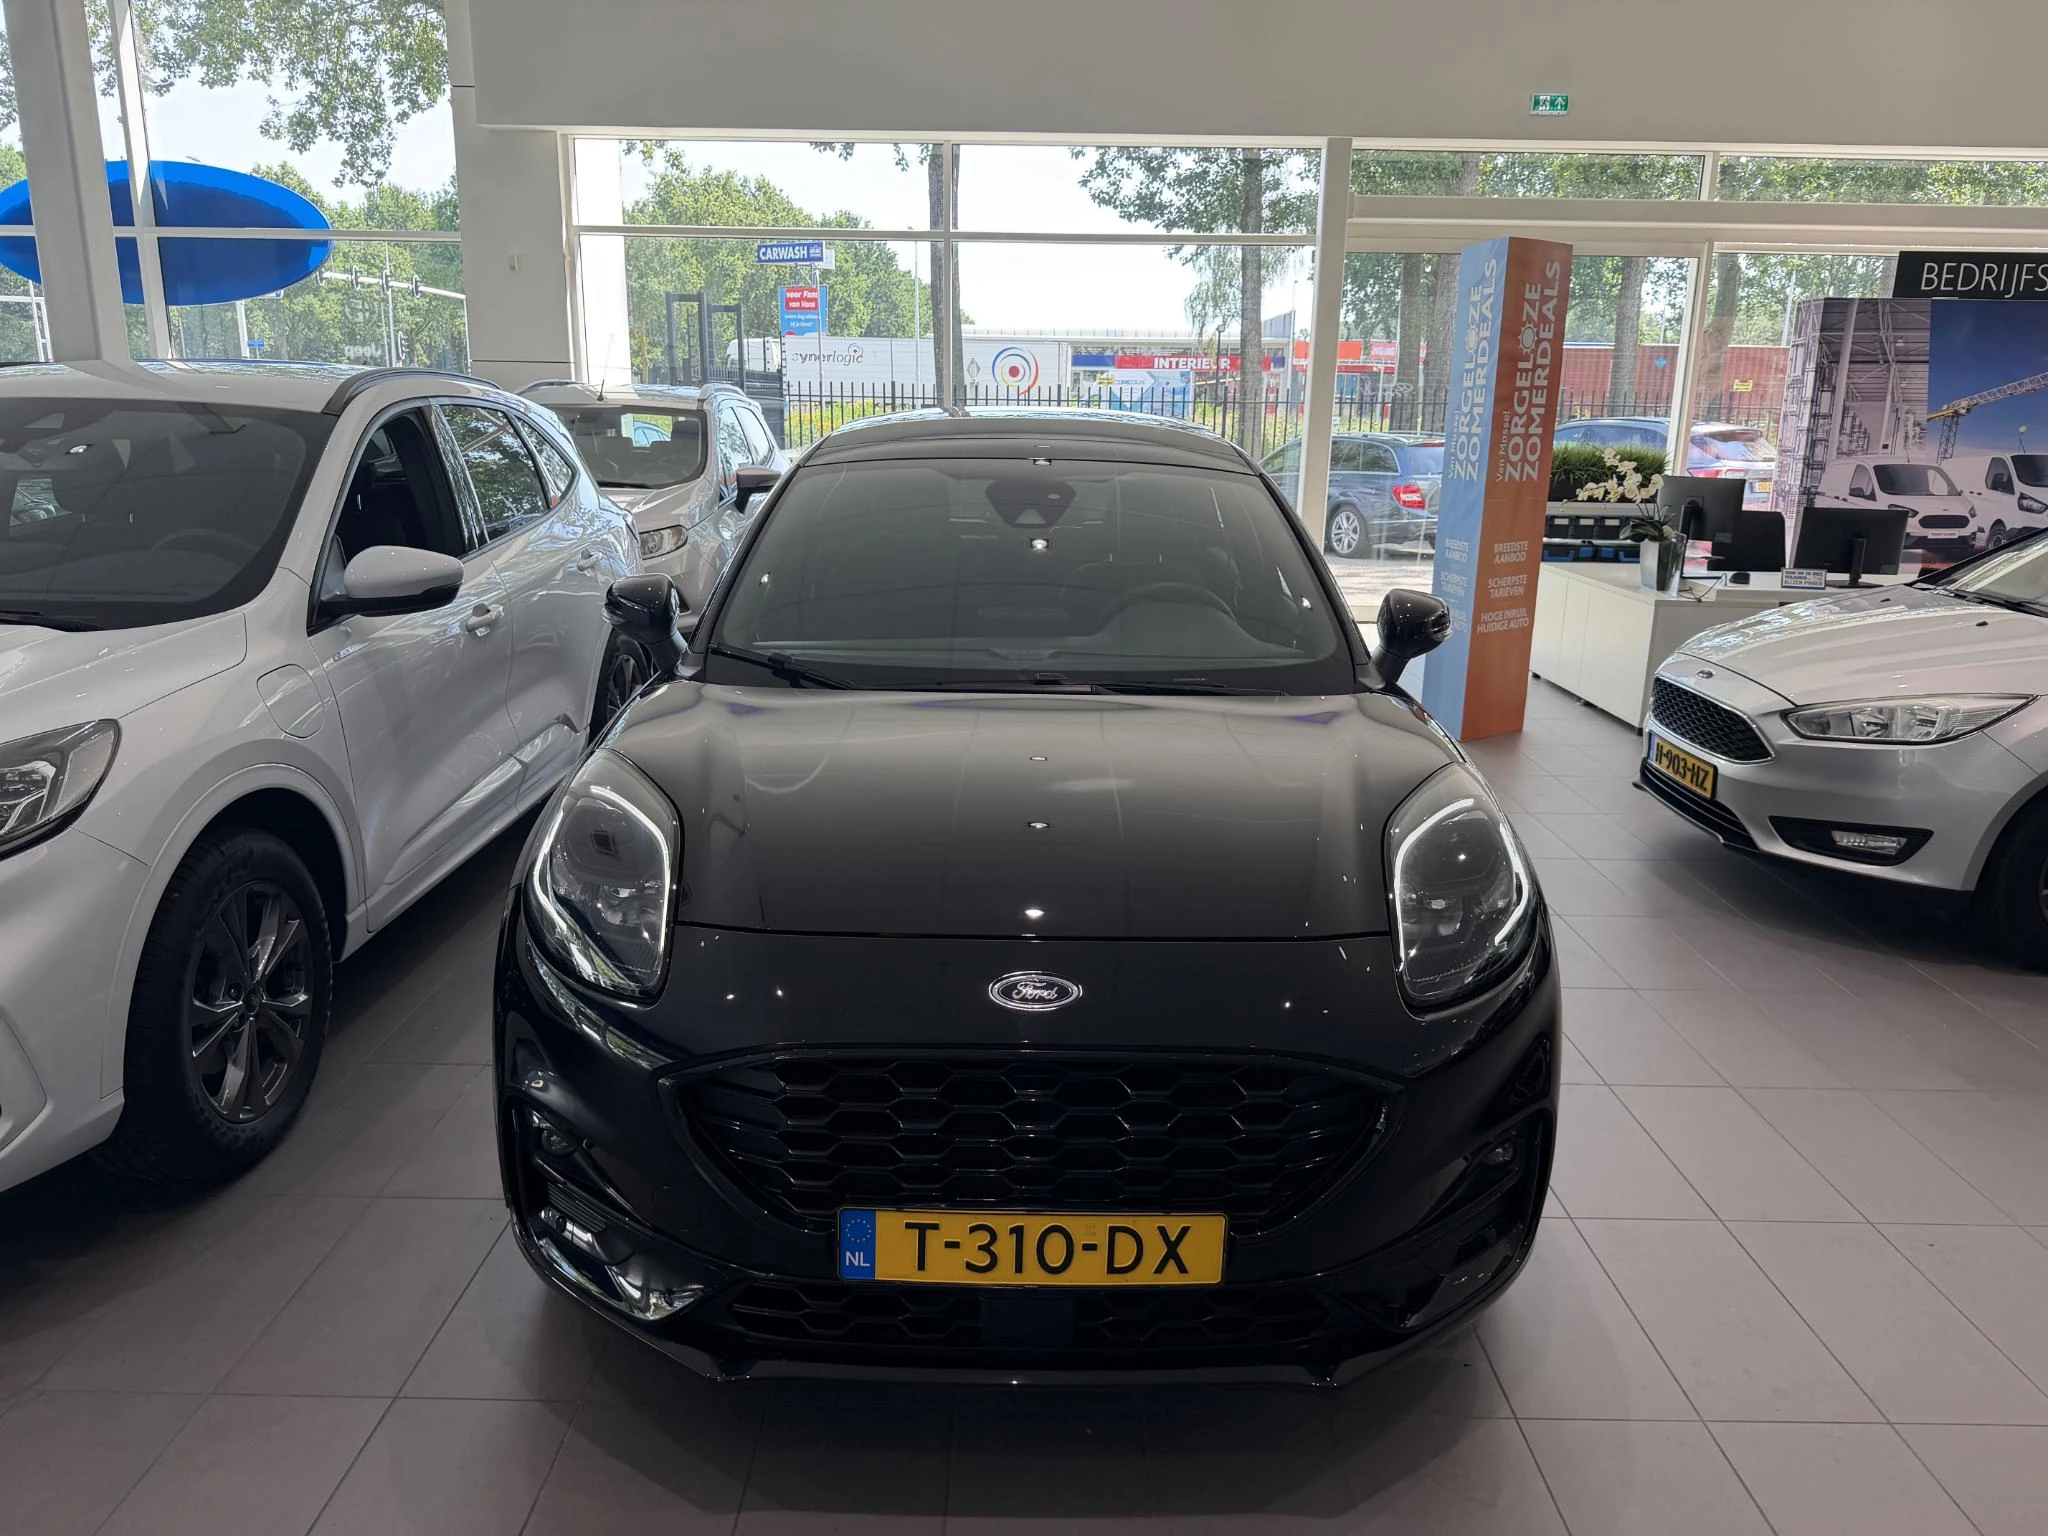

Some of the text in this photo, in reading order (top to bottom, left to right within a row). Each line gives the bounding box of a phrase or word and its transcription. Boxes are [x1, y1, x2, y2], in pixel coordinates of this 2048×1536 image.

[760, 245, 807, 260] CARWASH
[1920, 262, 2048, 298] BEDRIJFS
[801, 300, 816, 308] Vans
[1154, 357, 1230, 369] INTERIEUR
[1466, 258, 1497, 482] ZOMERDEALS
[1522, 261, 1560, 482] ZOMERDEALS
[1496, 411, 1511, 482] Van Mossel
[1493, 541, 1528, 554] BREEDSTE
[1494, 552, 1526, 564] AANBOD
[1487, 575, 1528, 589] SCHERPSTE
[1489, 586, 1524, 598] TARIEVEN
[1481, 608, 1528, 622] HOGE INRUIL
[1477, 618, 1529, 633] HUIDIGE AUTO
[1655, 742, 1709, 791] H-903-HZ
[1012, 981, 1058, 1000] Ford
[904, 1220, 1192, 1275] T-310-DX
[846, 1251, 870, 1266] NL
